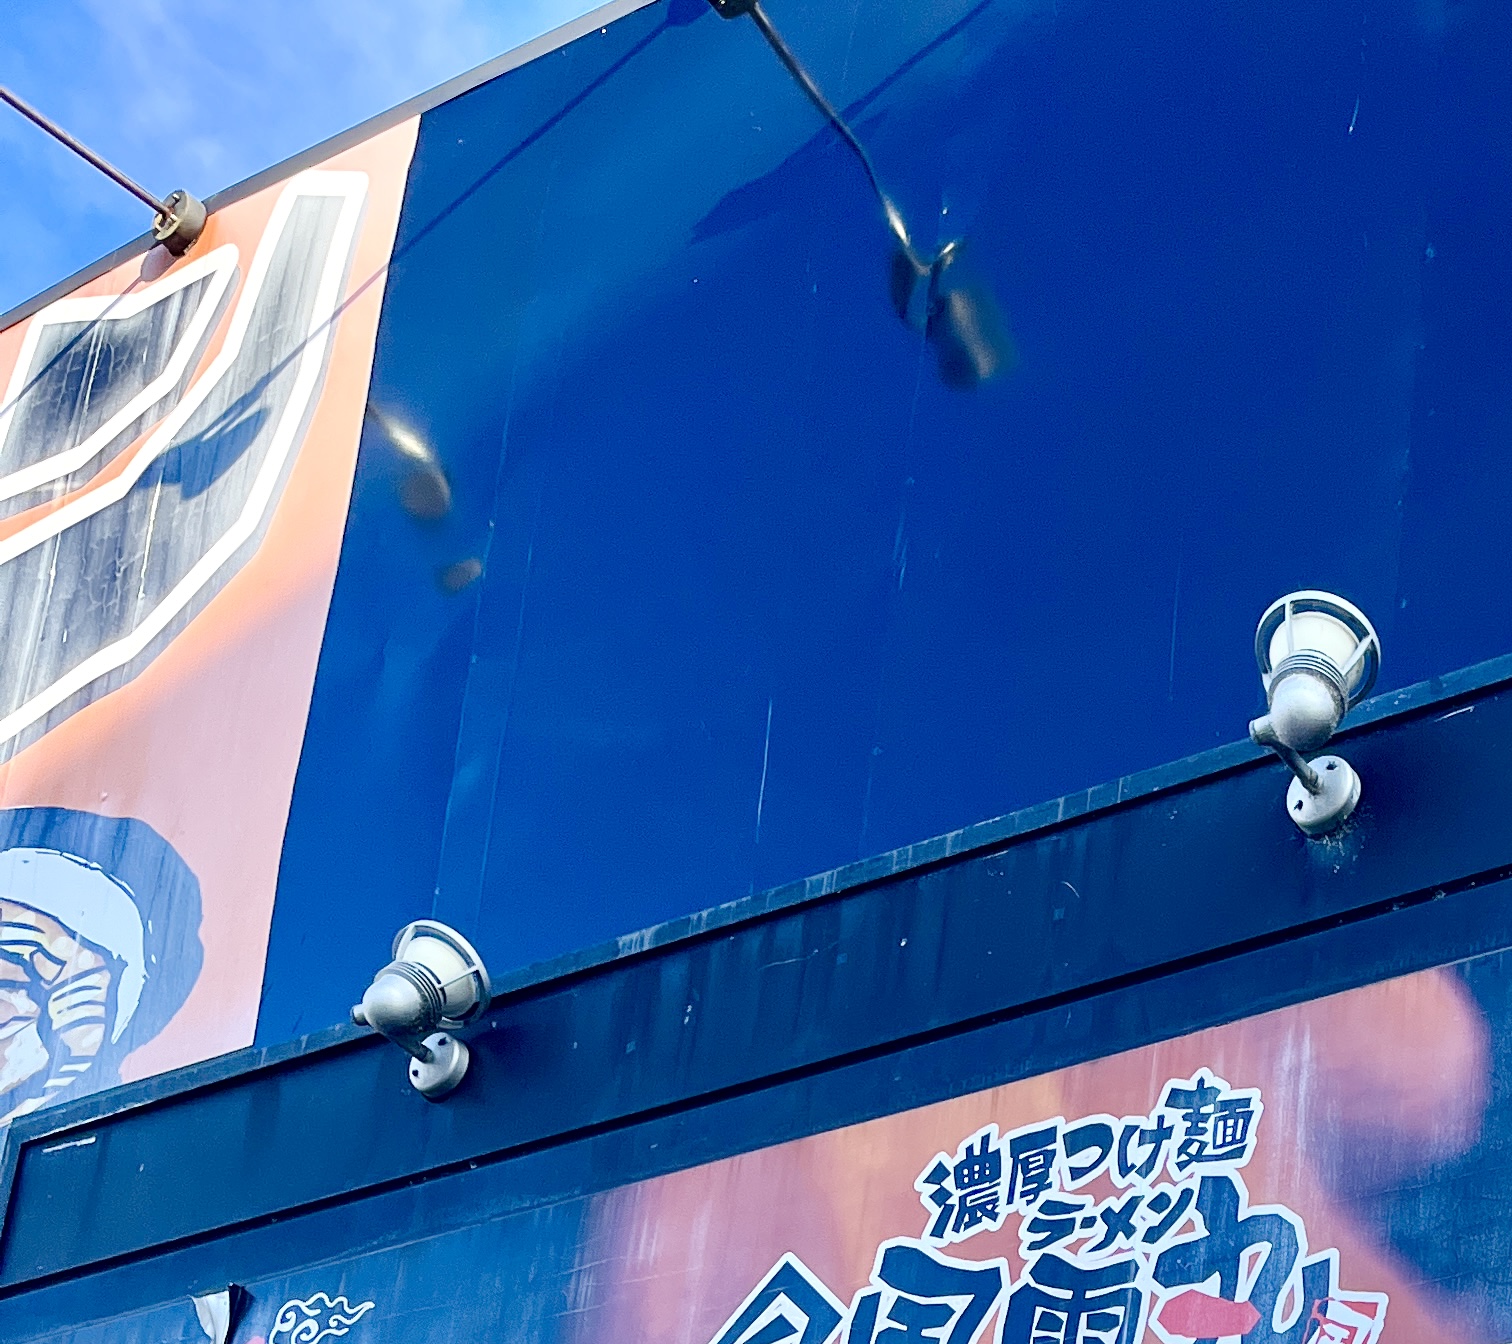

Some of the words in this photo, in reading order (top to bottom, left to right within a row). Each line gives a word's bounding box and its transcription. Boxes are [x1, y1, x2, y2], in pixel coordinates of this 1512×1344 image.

[916, 1066, 1262, 1243] 濃厚つけ麺
[1018, 1181, 1202, 1260] ラーメン
